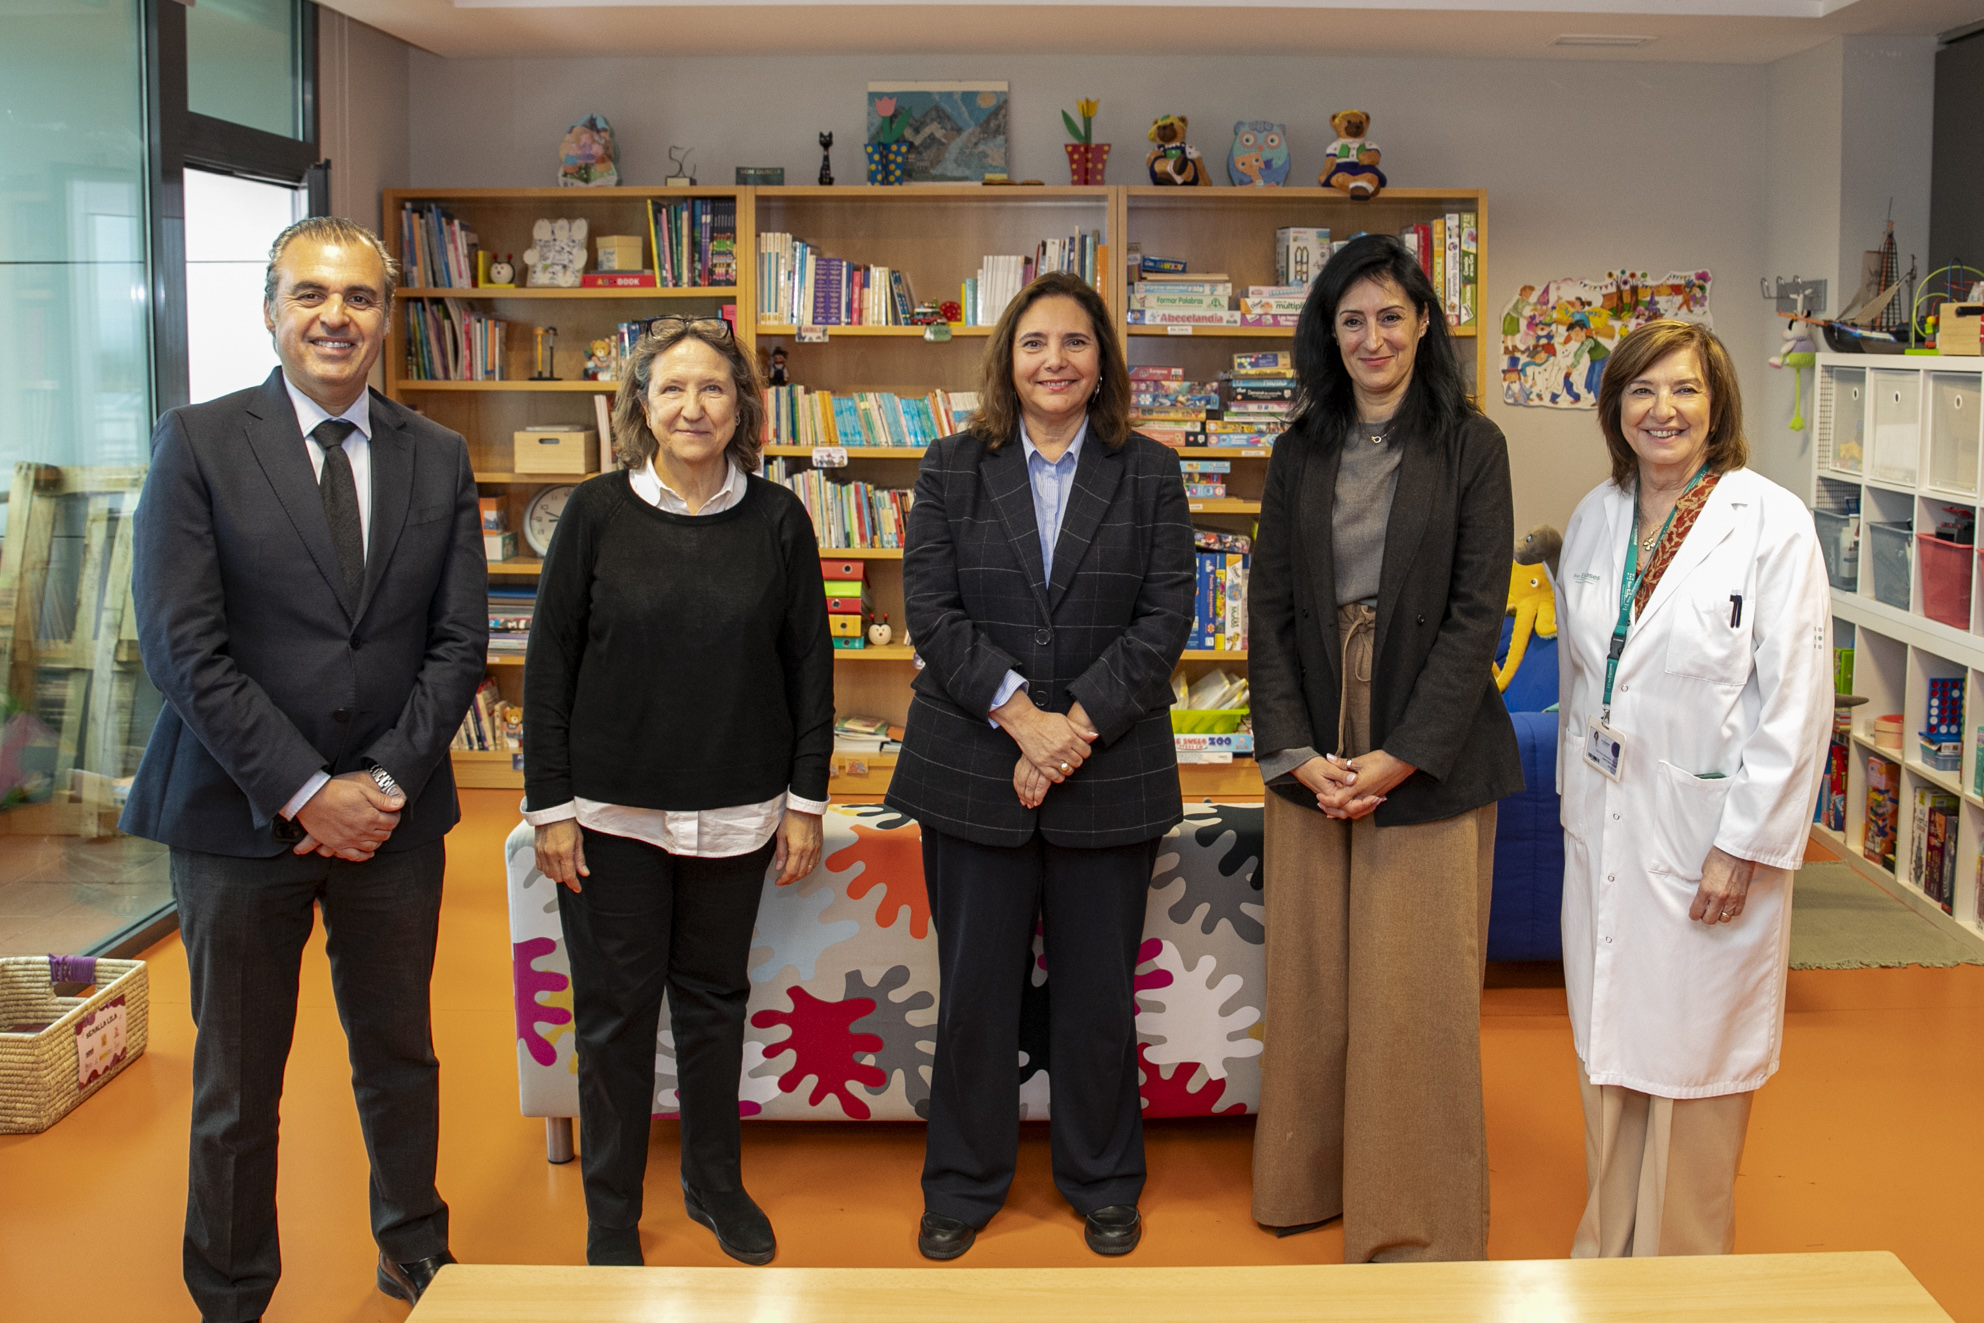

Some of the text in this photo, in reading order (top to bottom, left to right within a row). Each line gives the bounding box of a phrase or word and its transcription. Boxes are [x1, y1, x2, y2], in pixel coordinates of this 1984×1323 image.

[1156, 296, 1204, 305] Formar Palabras
[1160, 312, 1224, 324] Abecelandia
[1208, 736, 1232, 746] ZOO
